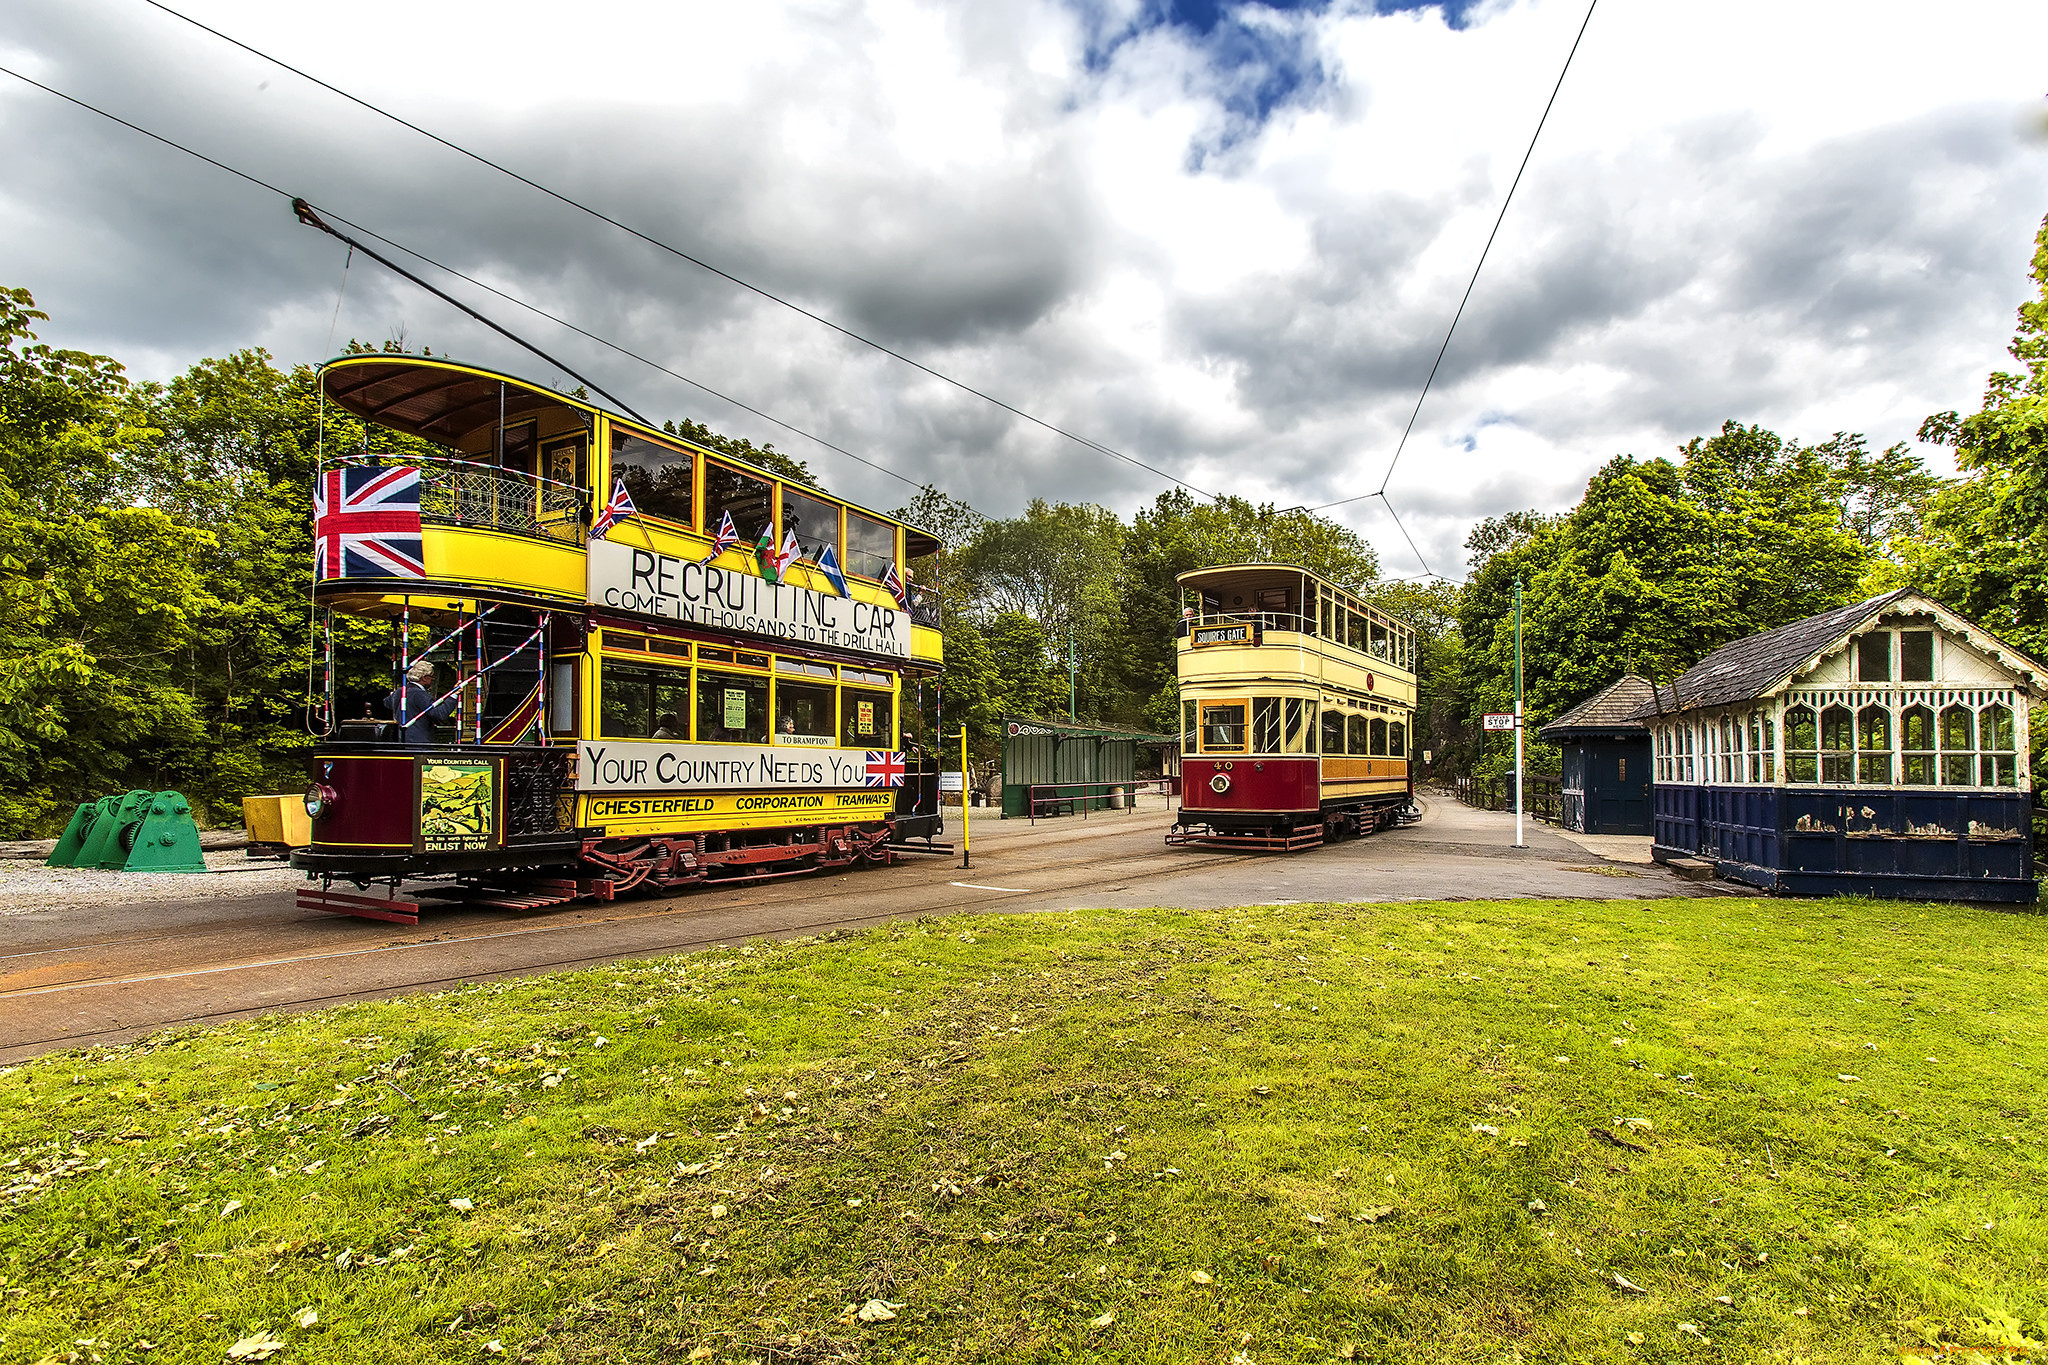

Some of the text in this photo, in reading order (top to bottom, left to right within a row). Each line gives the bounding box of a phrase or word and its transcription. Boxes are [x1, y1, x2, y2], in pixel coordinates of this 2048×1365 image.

[632, 548, 896, 640] RECRUITING CAR
[604, 586, 906, 656] COME IN THOUSANDS TO THE DRILL HALL
[1227, 628, 1245, 640] GATE
[783, 736, 828, 745] TO BRAMPTON
[323, 761, 334, 779] 7
[585, 746, 864, 786] YOUR COUNTRY NEEDS YOU
[1214, 762, 1233, 770] 40
[593, 794, 890, 815] CHESTERFIELD CORPORATION TRAMWAYS
[425, 841, 487, 850] ENLIST NOW
